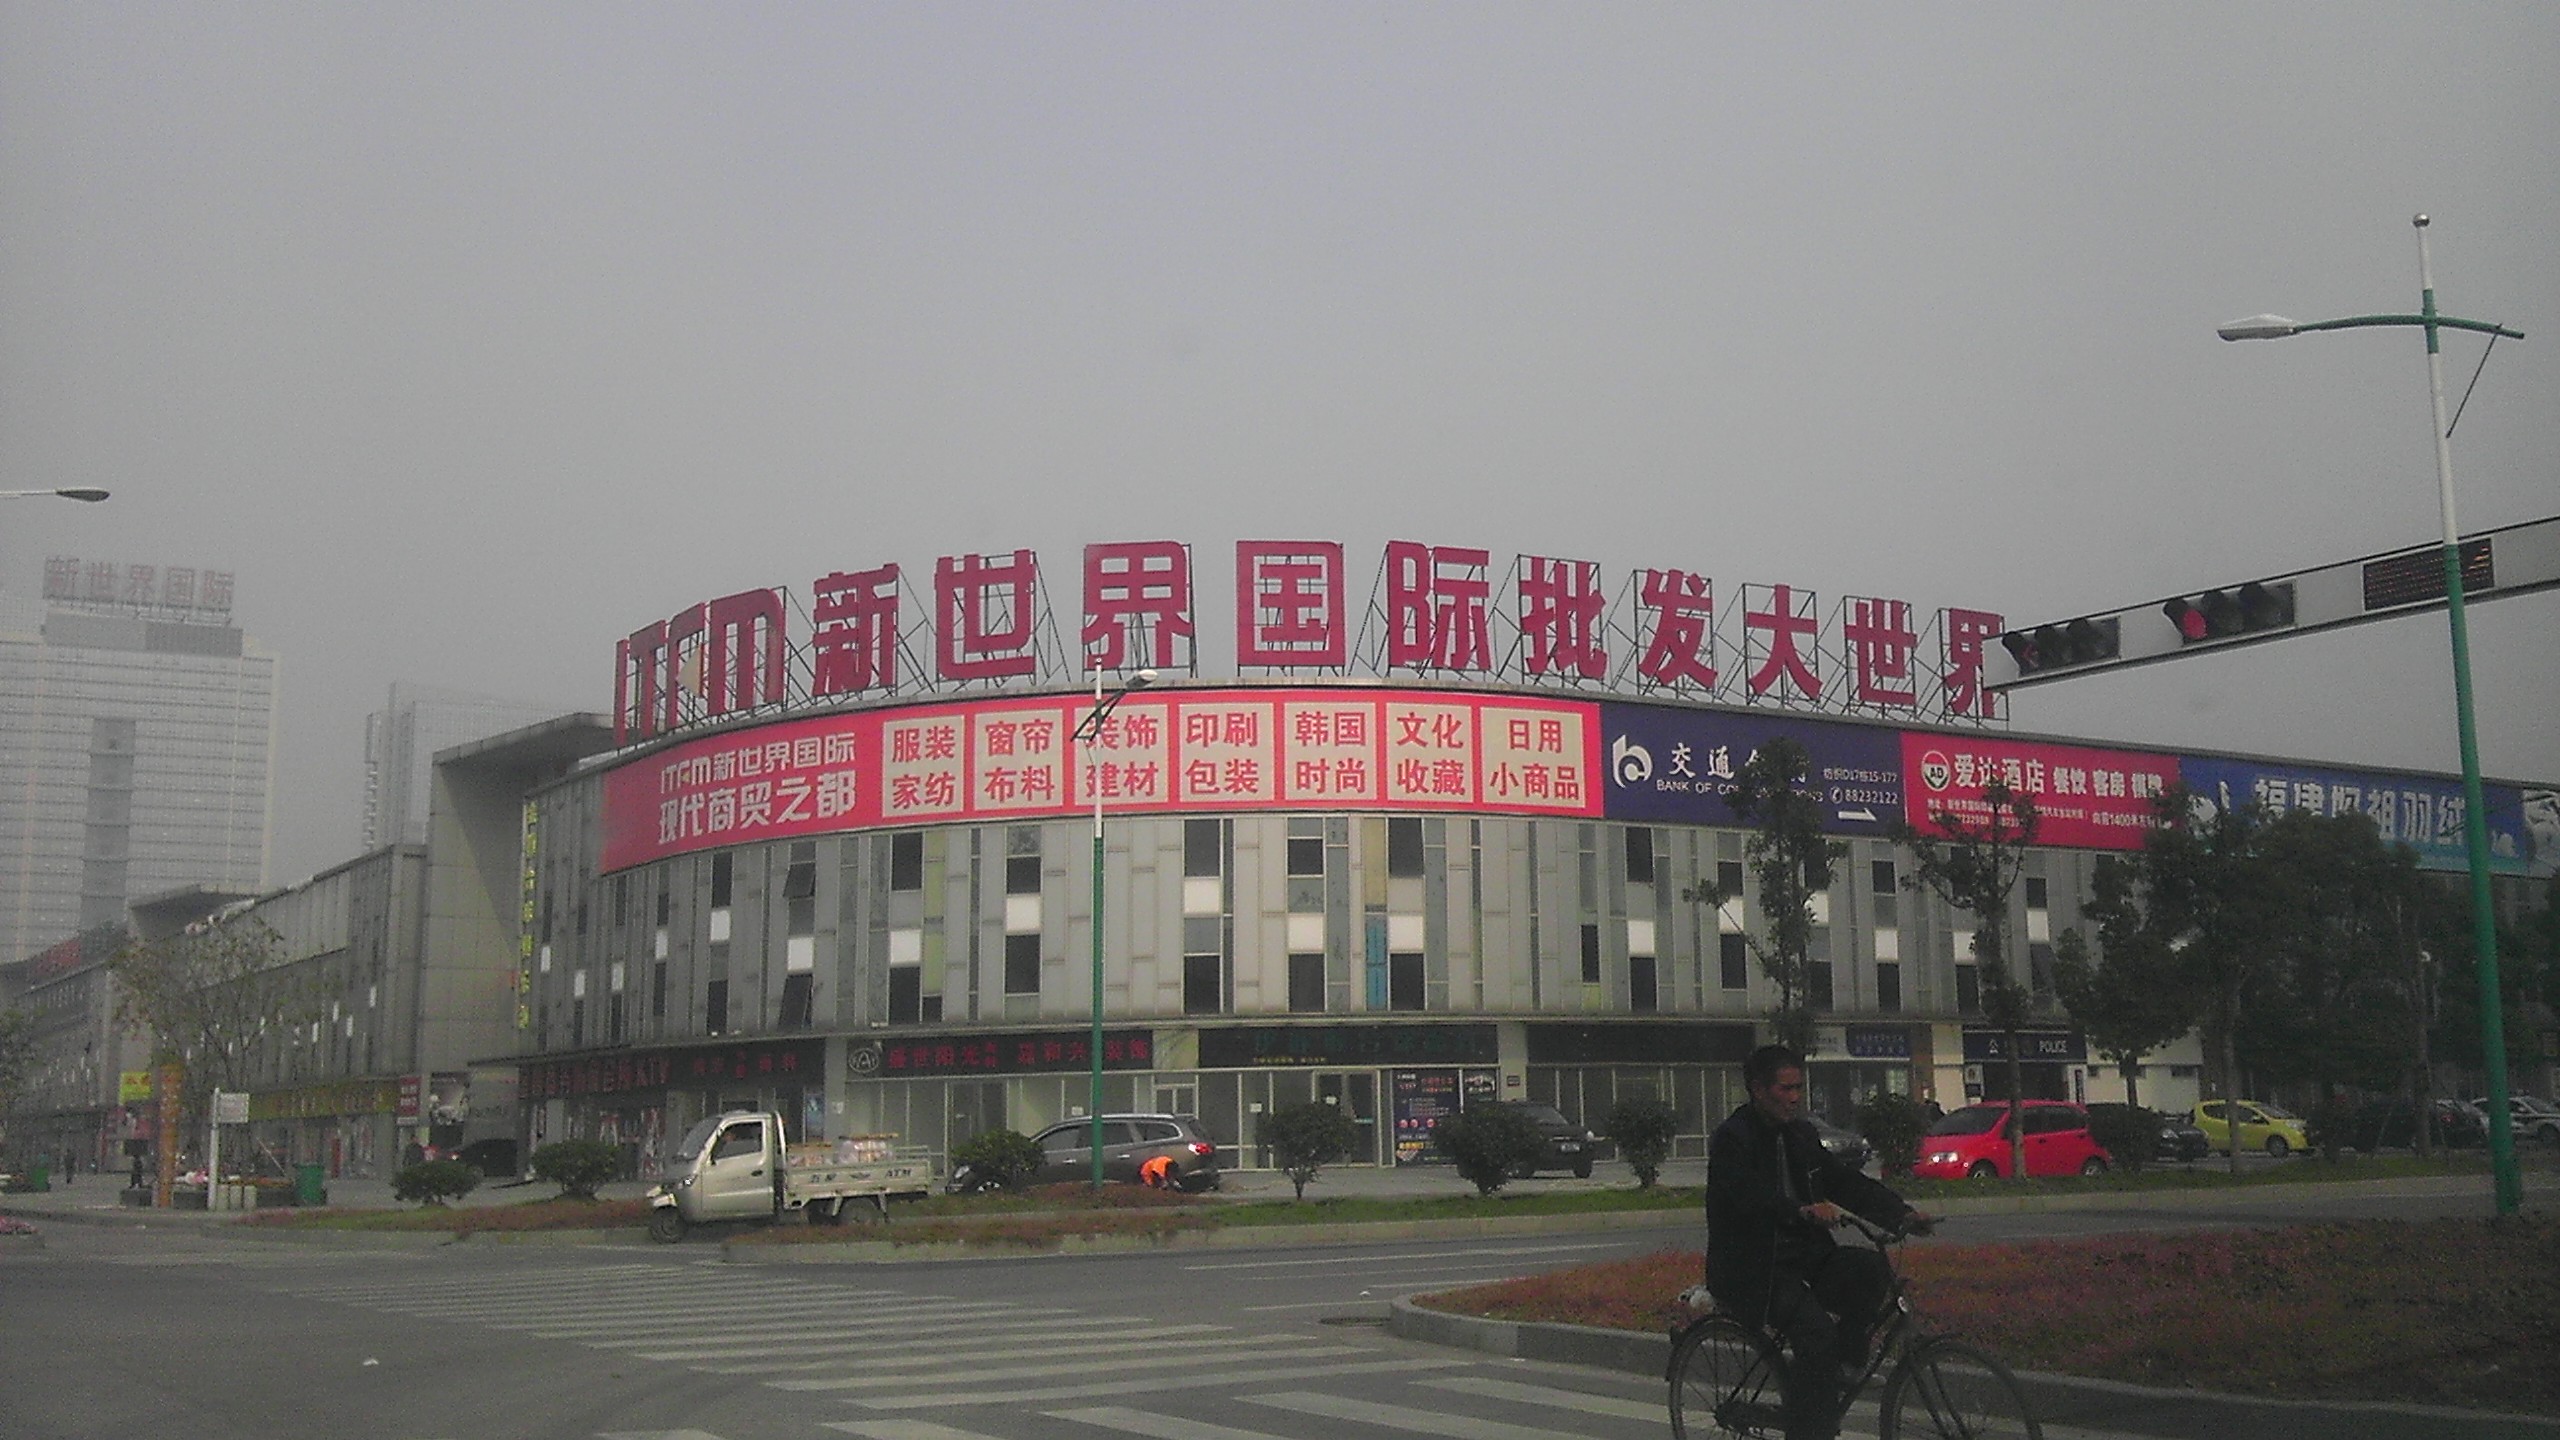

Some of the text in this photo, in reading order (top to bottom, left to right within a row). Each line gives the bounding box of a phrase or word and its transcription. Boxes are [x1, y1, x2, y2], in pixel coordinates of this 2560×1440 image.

[44, 556, 234, 608] 新世界国际
[892, 724, 955, 762] 服装
[985, 718, 1054, 757] 窗帘
[1186, 711, 1258, 748] 印刷
[1294, 712, 1368, 748] 韩国
[1396, 712, 1464, 749] 文化
[1507, 719, 1563, 754] 日用
[892, 771, 955, 810] 家纺
[985, 766, 1055, 802] 布料
[1086, 761, 1158, 797] 建材
[1185, 758, 1259, 795] 包装
[1294, 758, 1367, 794] 时尚
[1396, 758, 1466, 796] 收藏
[1489, 762, 1580, 800] 小商品
[1656, 779, 1690, 792] BANK
[1695, 782, 1712, 794] OF
[659, 769, 856, 845] 现代商贸之都
[1845, 788, 1898, 805] 88232122
[2039, 1040, 2067, 1053] POLICE
